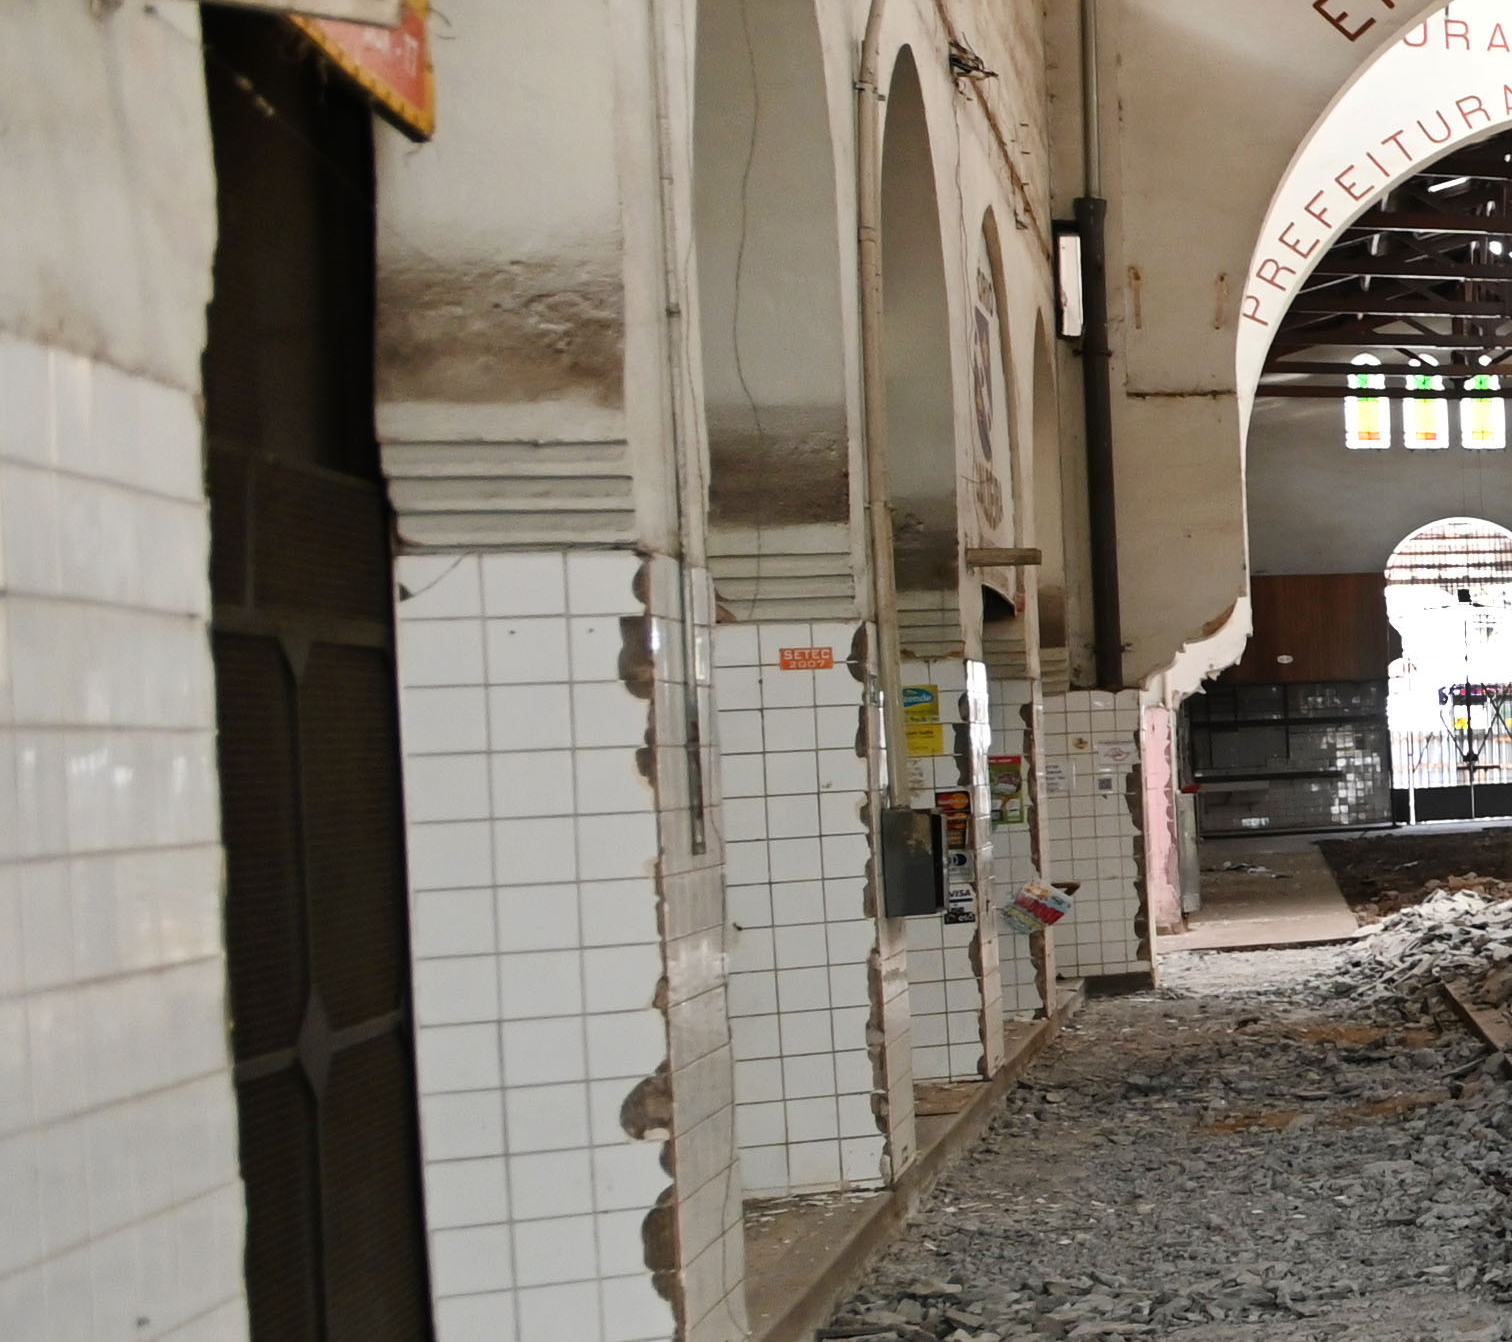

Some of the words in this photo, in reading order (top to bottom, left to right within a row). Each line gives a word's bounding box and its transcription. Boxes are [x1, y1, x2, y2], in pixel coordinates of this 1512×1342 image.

[783, 649, 830, 660] SETEC
[789, 659, 825, 668] 2007
[948, 889, 971, 898] VISA
